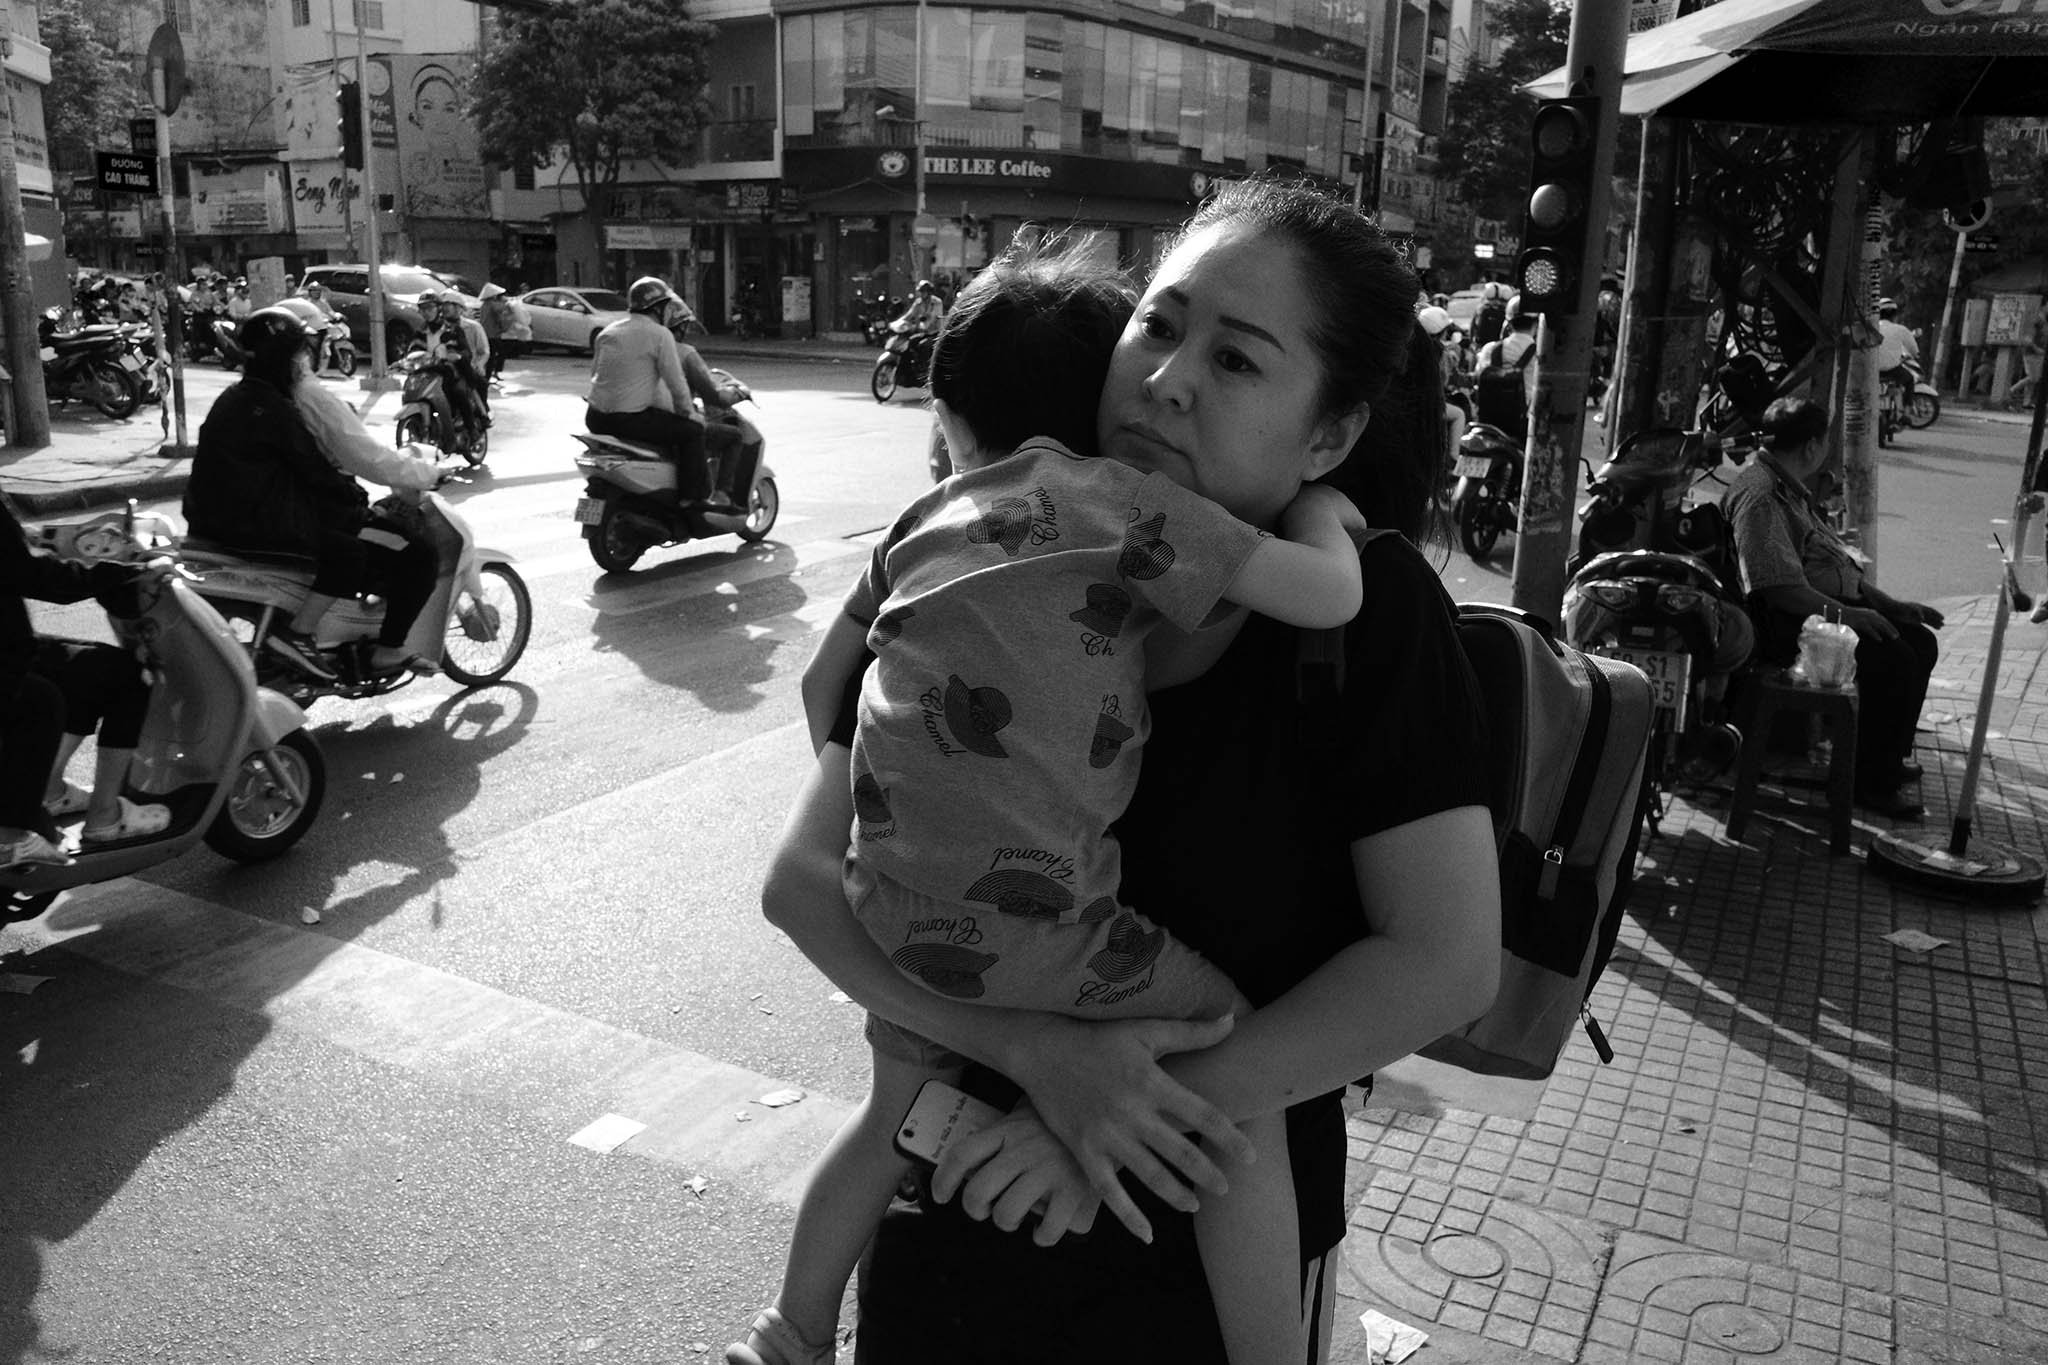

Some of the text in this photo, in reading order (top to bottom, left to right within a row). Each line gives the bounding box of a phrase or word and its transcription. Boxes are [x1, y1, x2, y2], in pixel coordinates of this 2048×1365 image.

[1989, 20, 2048, 36] hàn
[924, 156, 1052, 179] THE LEE Coffee
[105, 171, 122, 184] CAO
[859, 822, 897, 842] hamel
